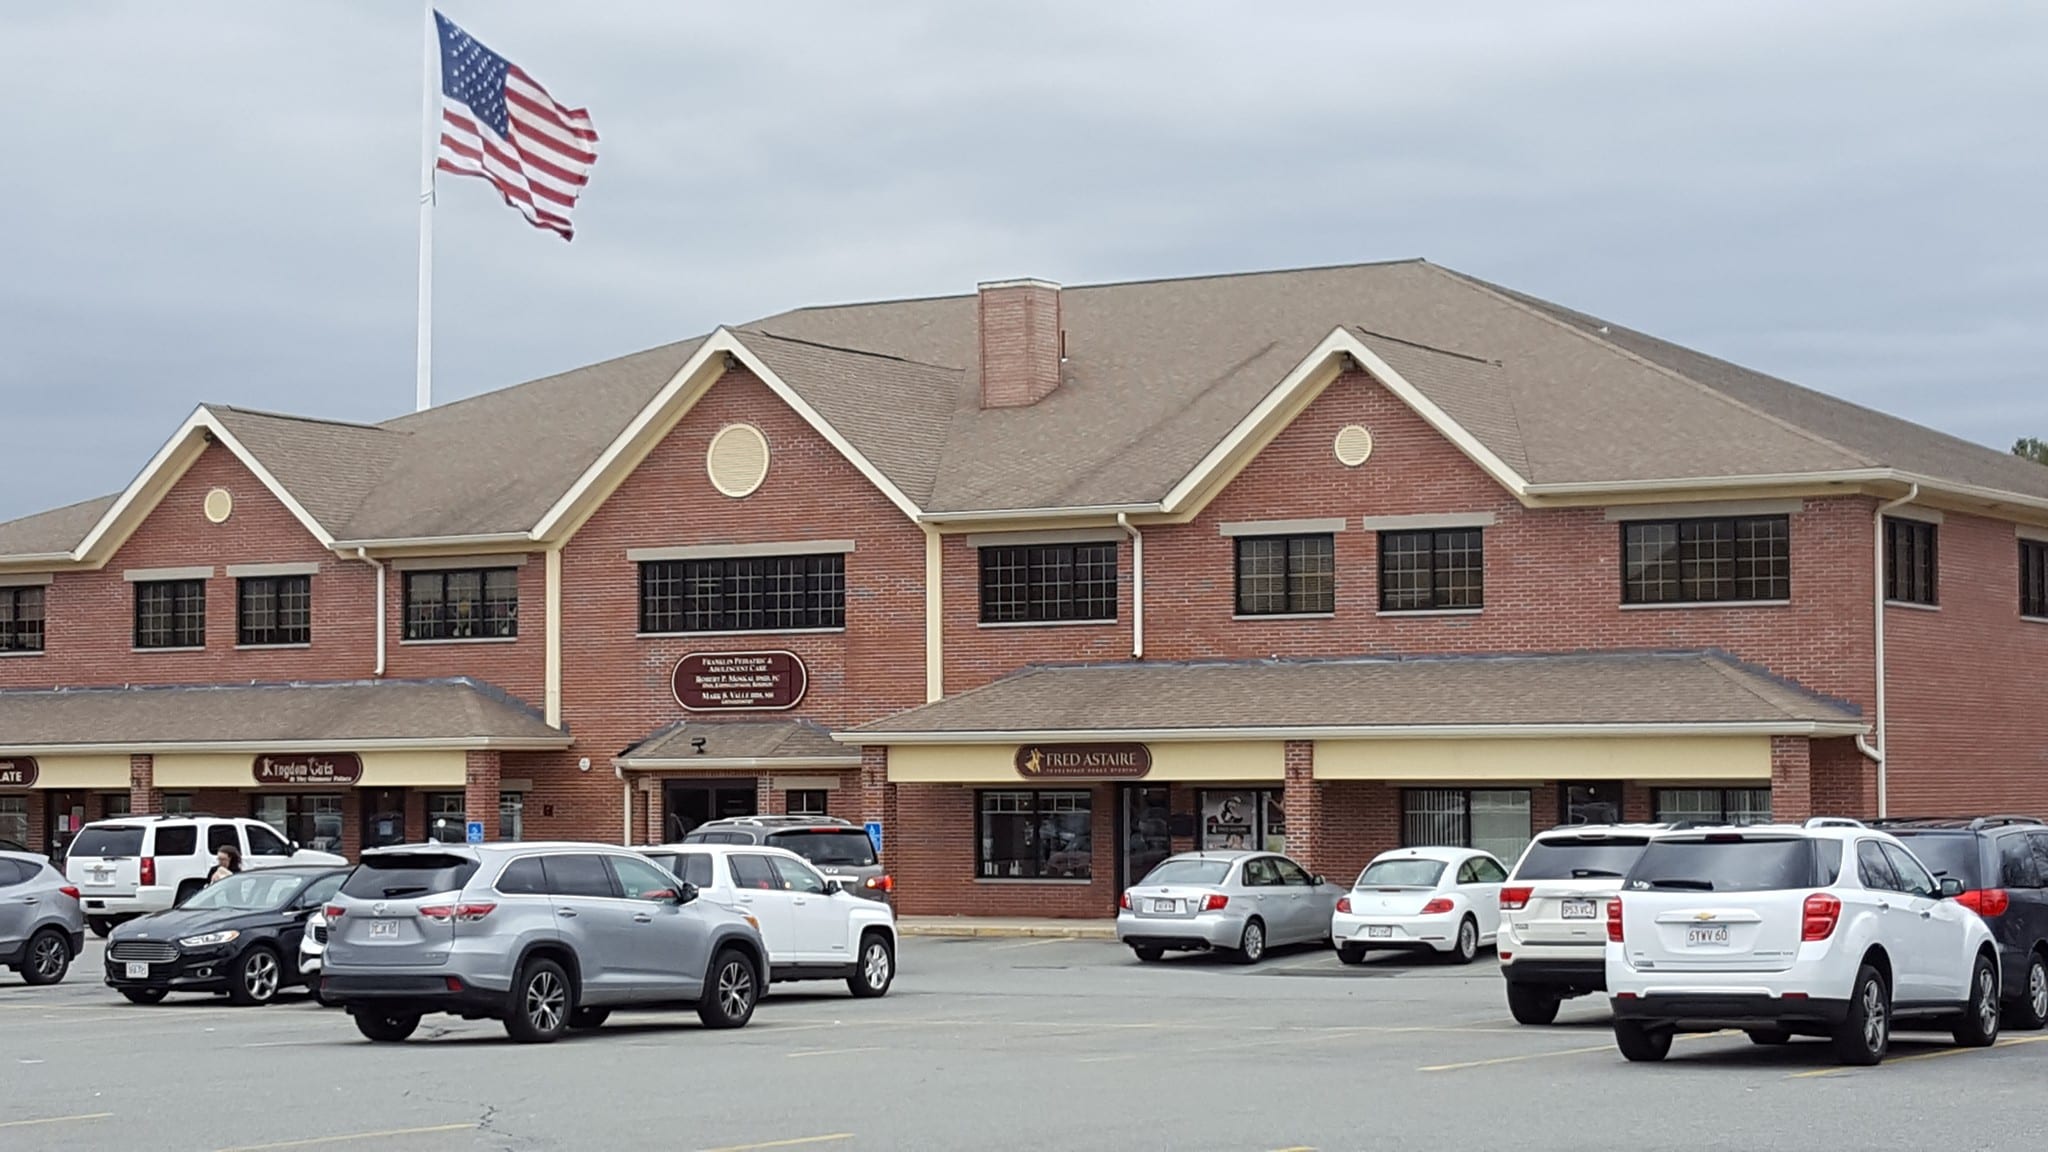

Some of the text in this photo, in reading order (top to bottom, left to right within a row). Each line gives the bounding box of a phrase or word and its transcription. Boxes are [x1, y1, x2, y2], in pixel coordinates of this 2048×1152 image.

[1046, 752, 1137, 767] FRED ASTAIRE
[262, 757, 308, 779] Kingdom
[1715, 929, 1727, 941] 60
